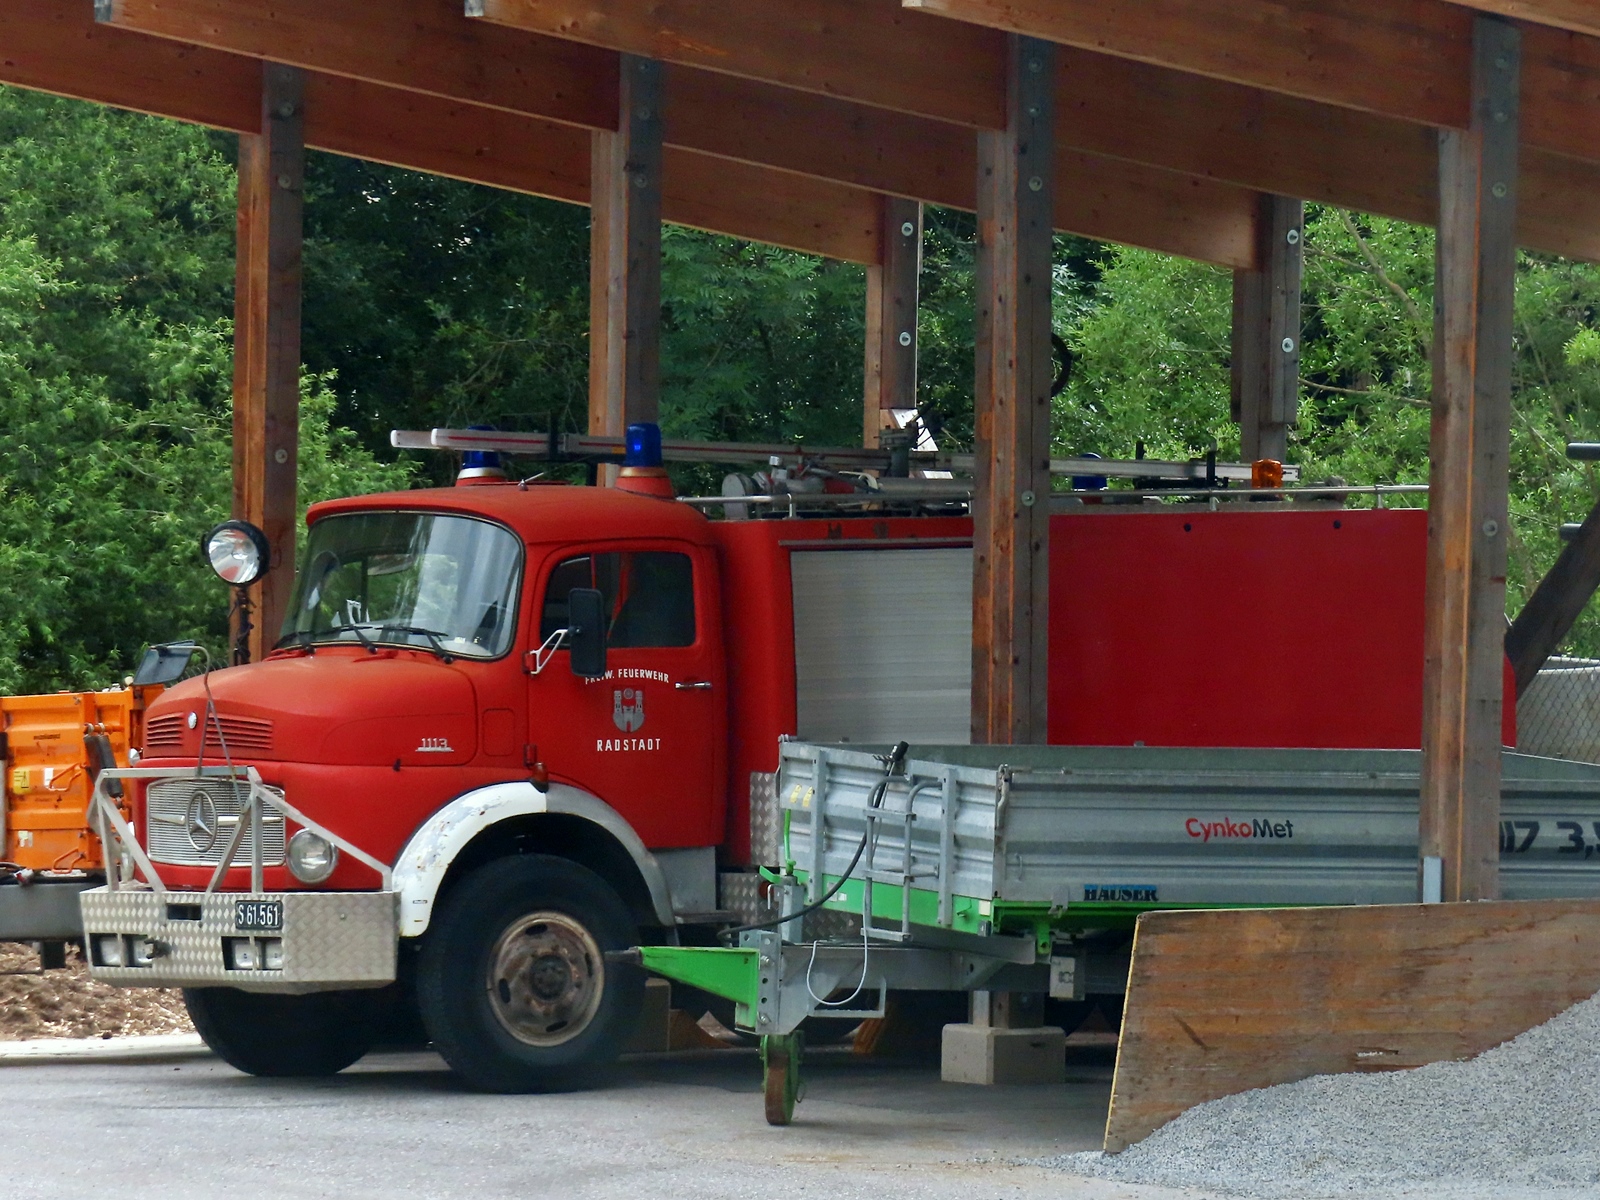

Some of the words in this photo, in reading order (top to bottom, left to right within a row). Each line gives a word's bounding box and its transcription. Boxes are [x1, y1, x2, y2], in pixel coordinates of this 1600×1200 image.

[618, 668, 670, 683] FEUERWEHR
[420, 737, 449, 749] 1113
[596, 738, 661, 752] RADSTADT
[1185, 817, 1294, 842] CynkoMet
[1556, 821, 1600, 861] 3,
[1083, 884, 1159, 902] HAUSER
